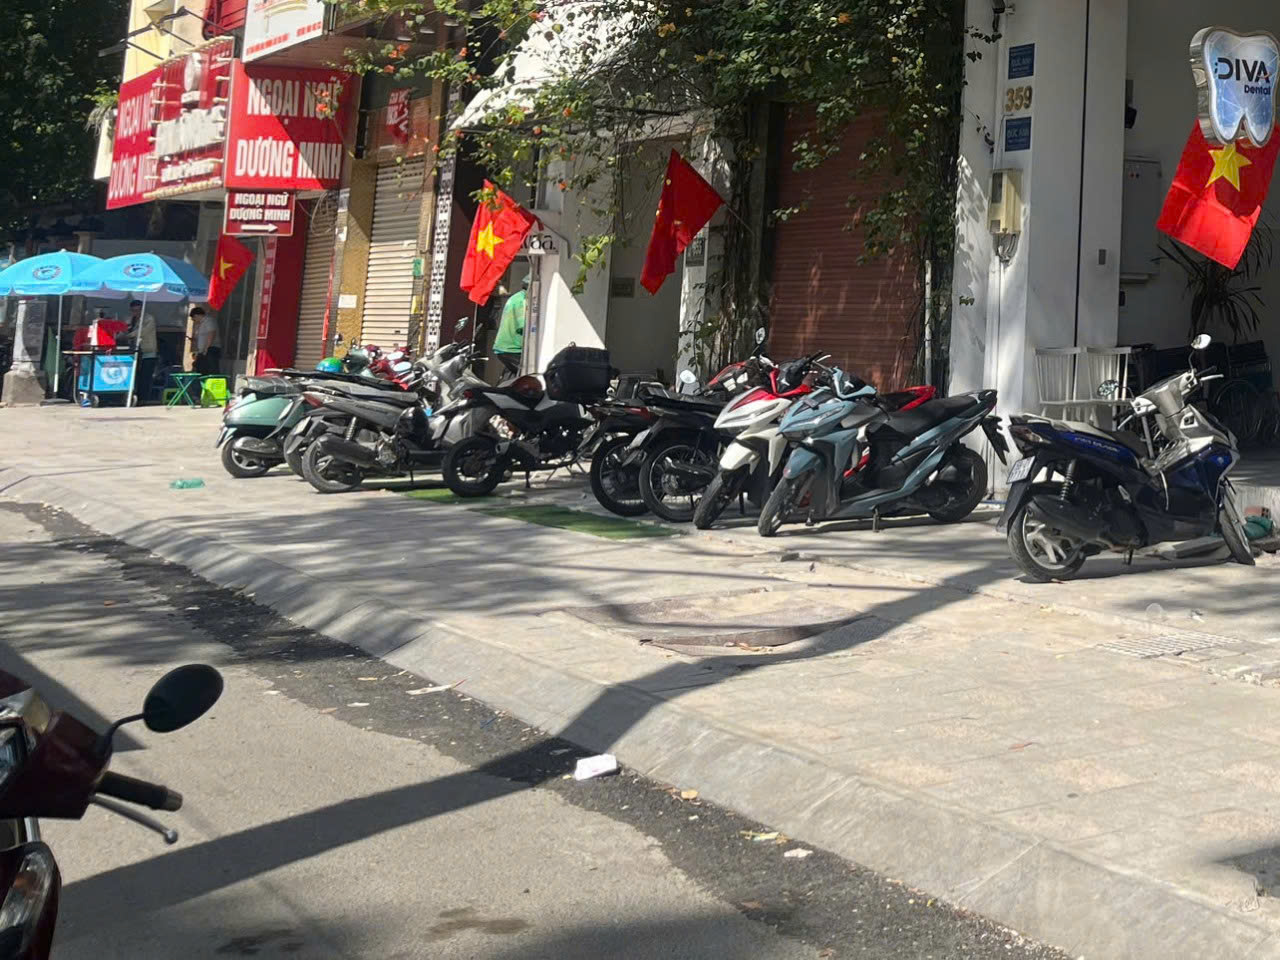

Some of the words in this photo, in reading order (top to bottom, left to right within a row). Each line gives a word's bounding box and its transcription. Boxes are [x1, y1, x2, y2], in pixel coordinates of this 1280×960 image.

[1215, 57, 1270, 83] DIVA
[248, 78, 299, 125] NGOẠI
[1005, 86, 1033, 112] 359
[1244, 85, 1271, 95] Dental
[235, 136, 295, 178] DƯƠNG
[297, 141, 342, 179] MINH
[264, 209, 290, 221] MINH
